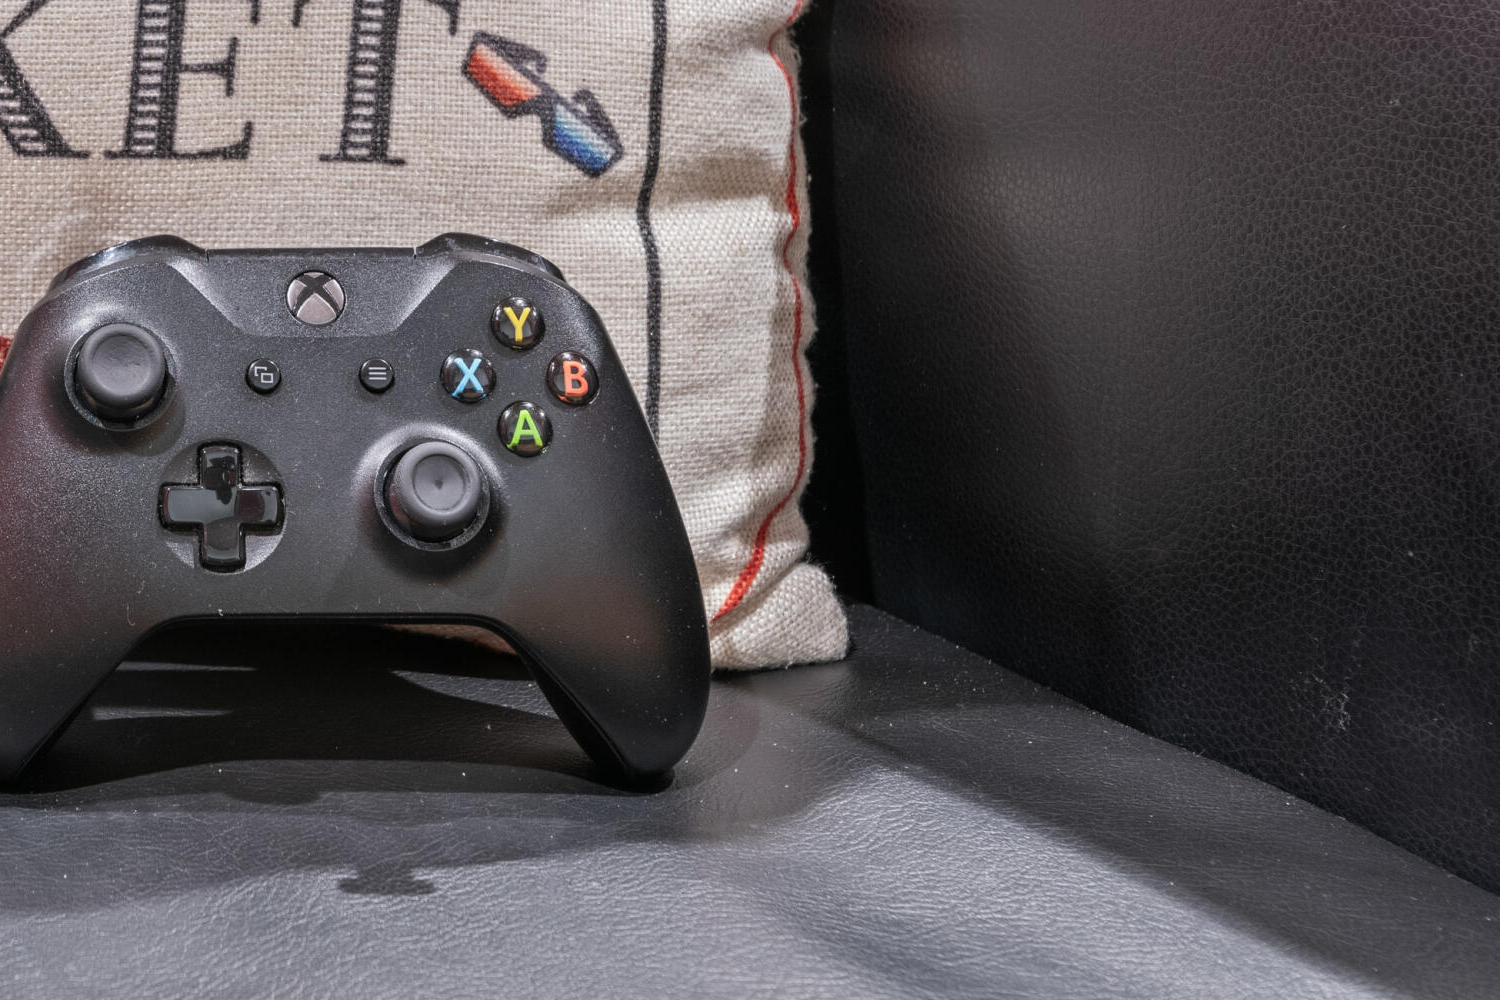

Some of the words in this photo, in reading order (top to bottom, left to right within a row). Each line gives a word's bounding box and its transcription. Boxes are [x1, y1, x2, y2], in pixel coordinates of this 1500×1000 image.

[503, 306, 531, 342] Y
[452, 357, 485, 397] X
[563, 360, 588, 396] B
[506, 409, 543, 449] A
